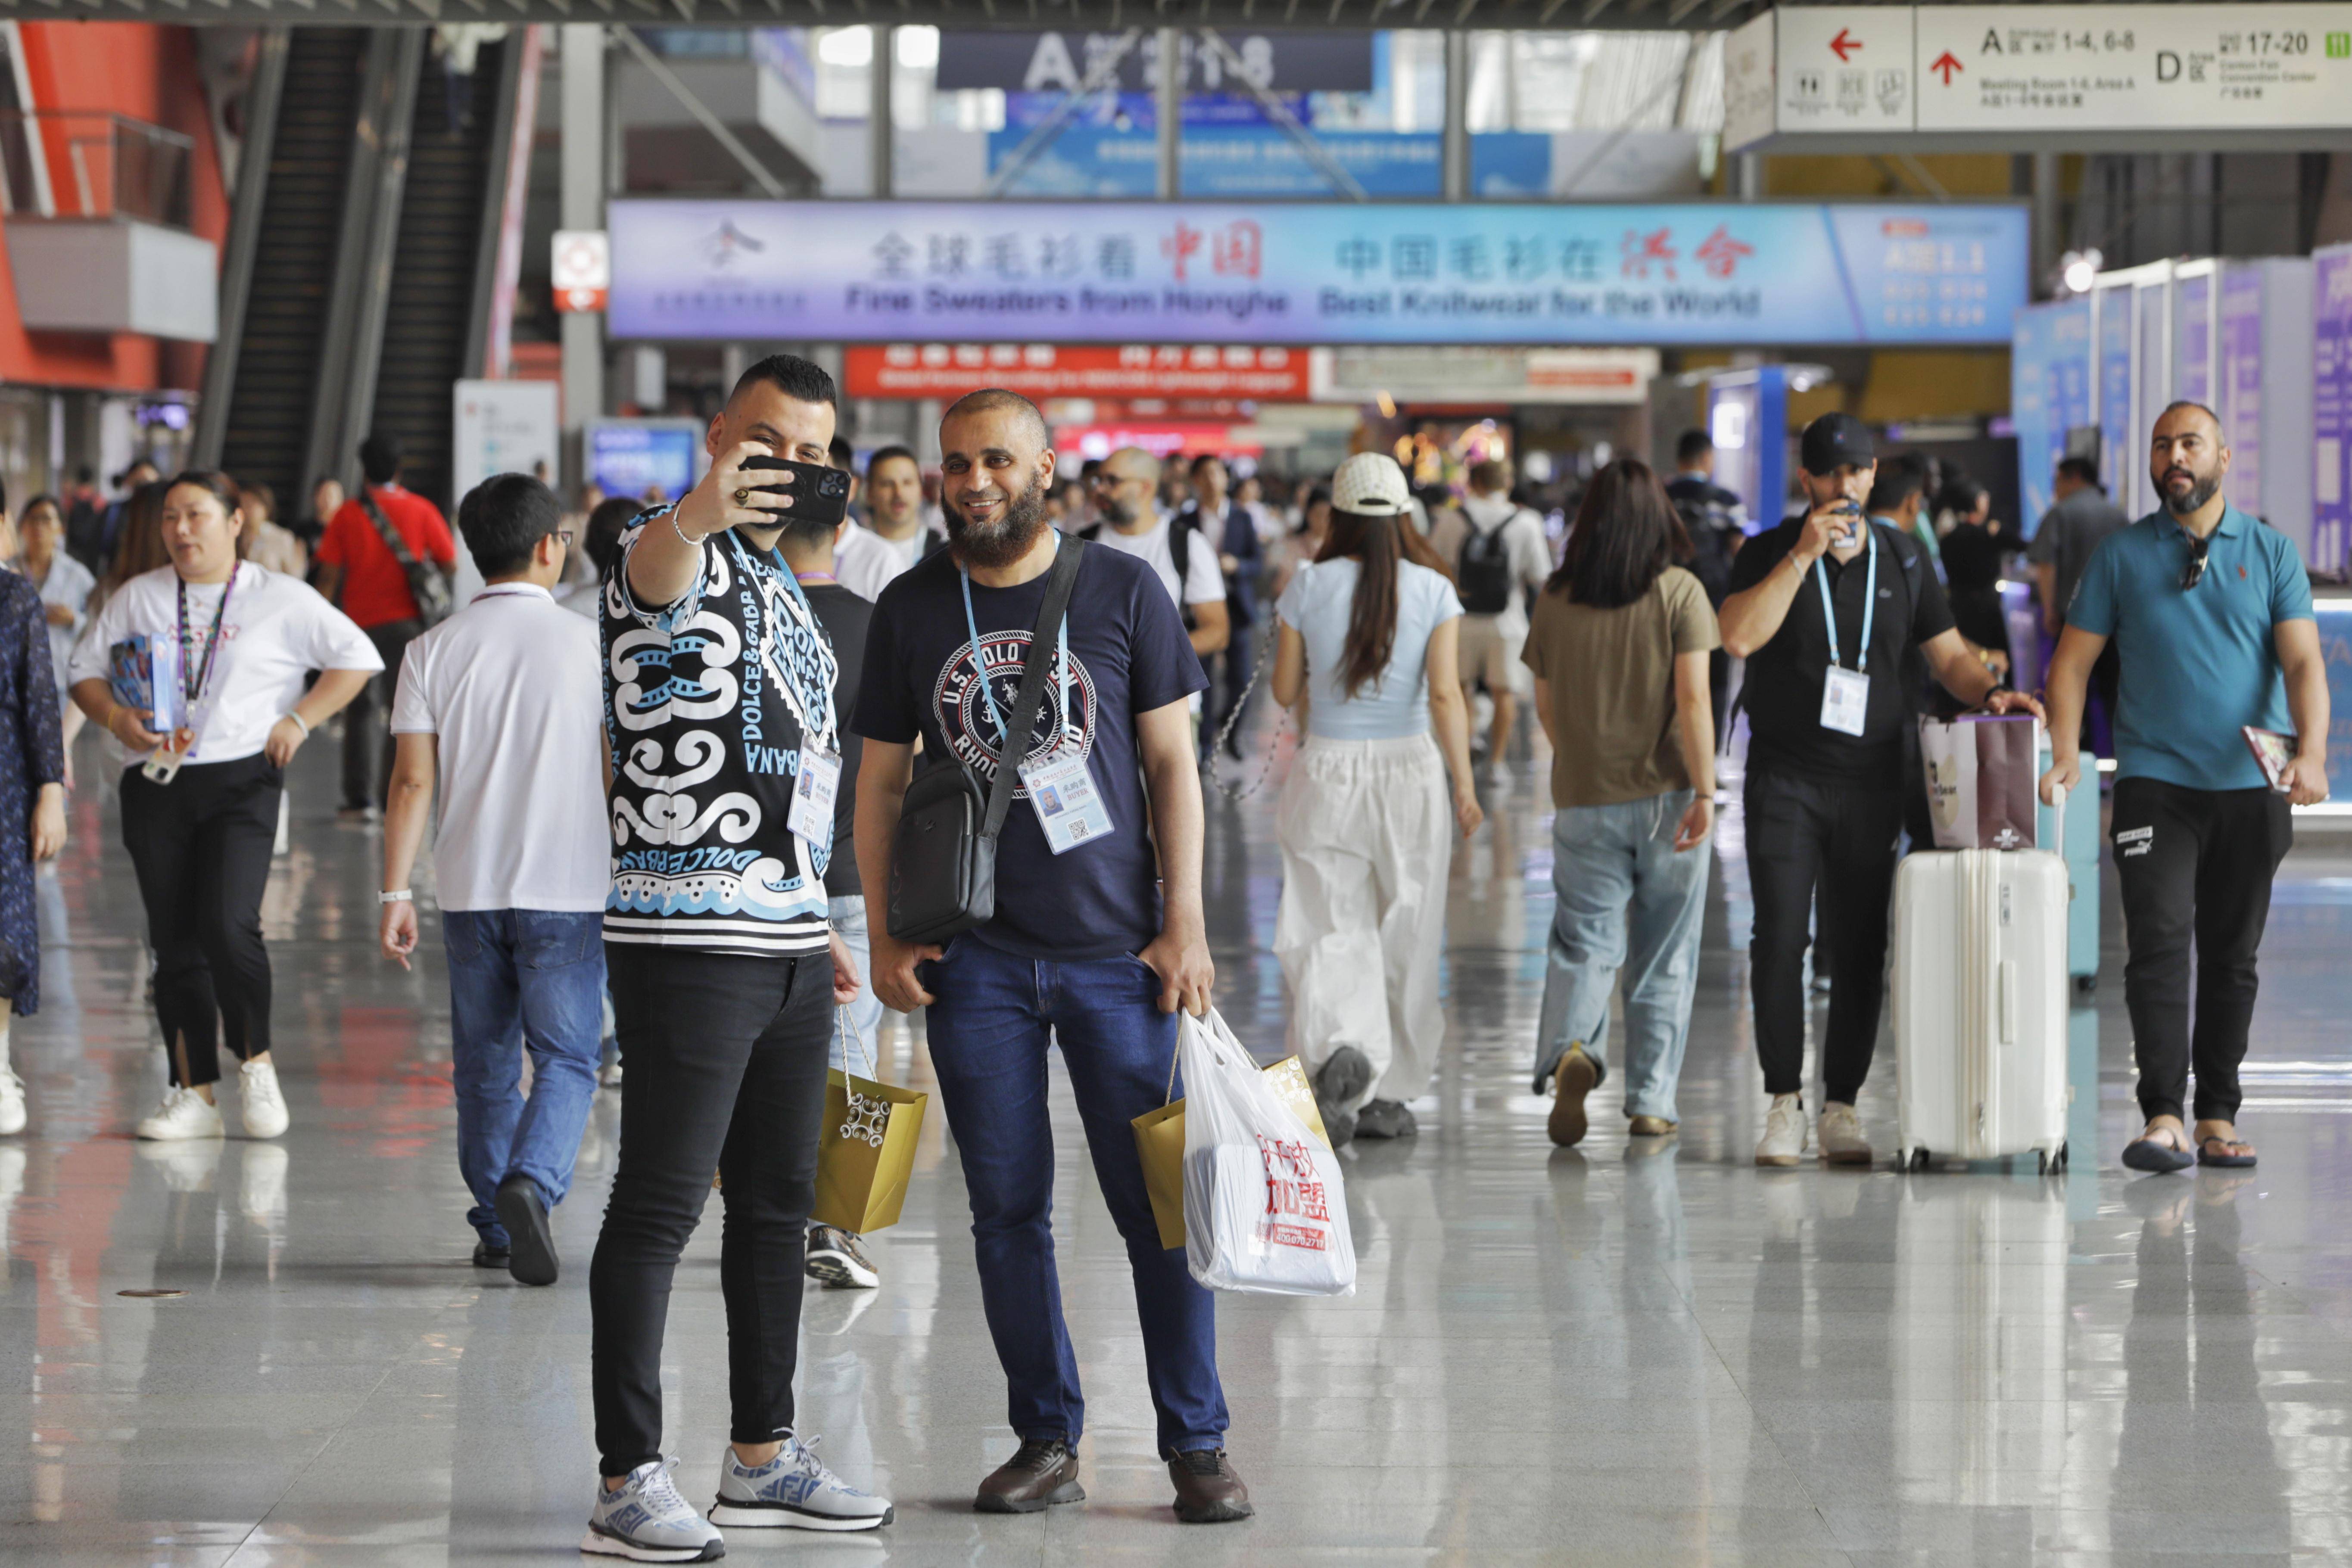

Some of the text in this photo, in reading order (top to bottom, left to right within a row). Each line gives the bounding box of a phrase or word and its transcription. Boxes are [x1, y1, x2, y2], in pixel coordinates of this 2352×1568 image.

[1981, 27, 2003, 54] A
[2248, 31, 2308, 54] 17-20
[2157, 50, 2181, 83] D
[845, 283, 913, 313] Fine
[925, 284, 1072, 315] Sweaters
[1080, 283, 1157, 314] from
[1162, 286, 1289, 321] Honghe
[1320, 285, 1760, 317] Best Knitwear for the World
[743, 647, 760, 664] &
[942, 670, 972, 704] U.S.
[742, 664, 763, 740] DOLCE
[1062, 778, 1087, 793] 采购商
[1067, 788, 1089, 801] BUYER
[669, 846, 762, 874] DOLCE
[1265, 1174, 1330, 1222] 加盟
[1277, 1233, 1290, 1242] 400
[1291, 1235, 1305, 1245] 070
[1306, 1238, 1324, 1248] 2717
